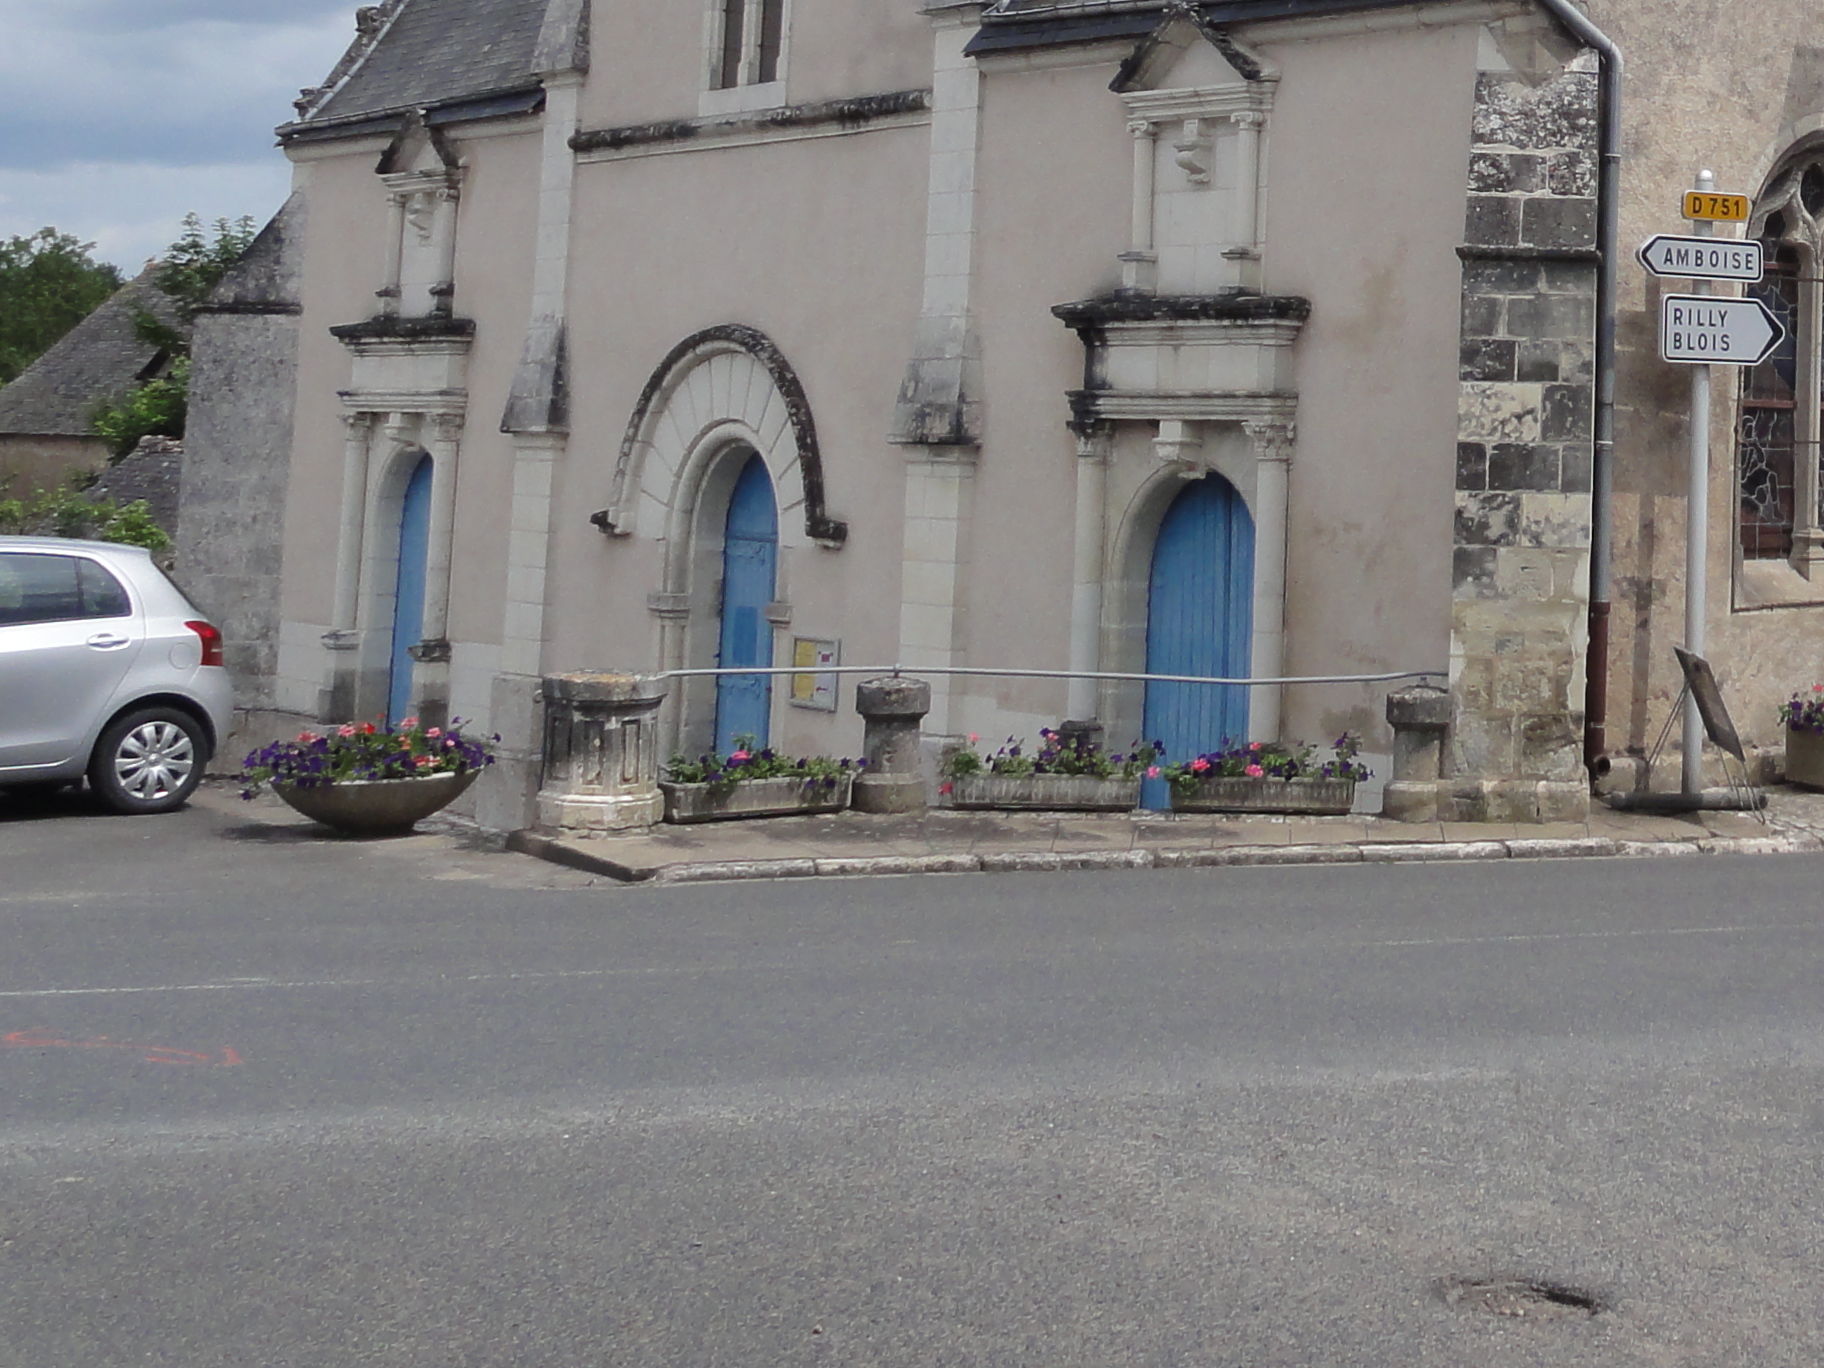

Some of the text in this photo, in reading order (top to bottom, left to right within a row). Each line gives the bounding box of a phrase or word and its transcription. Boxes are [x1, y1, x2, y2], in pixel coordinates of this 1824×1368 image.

[1692, 196, 1740, 217] D 751
[1663, 247, 1754, 271] AMBOISE
[1673, 308, 1728, 327] RILLY
[1673, 332, 1730, 351] BLOIS
